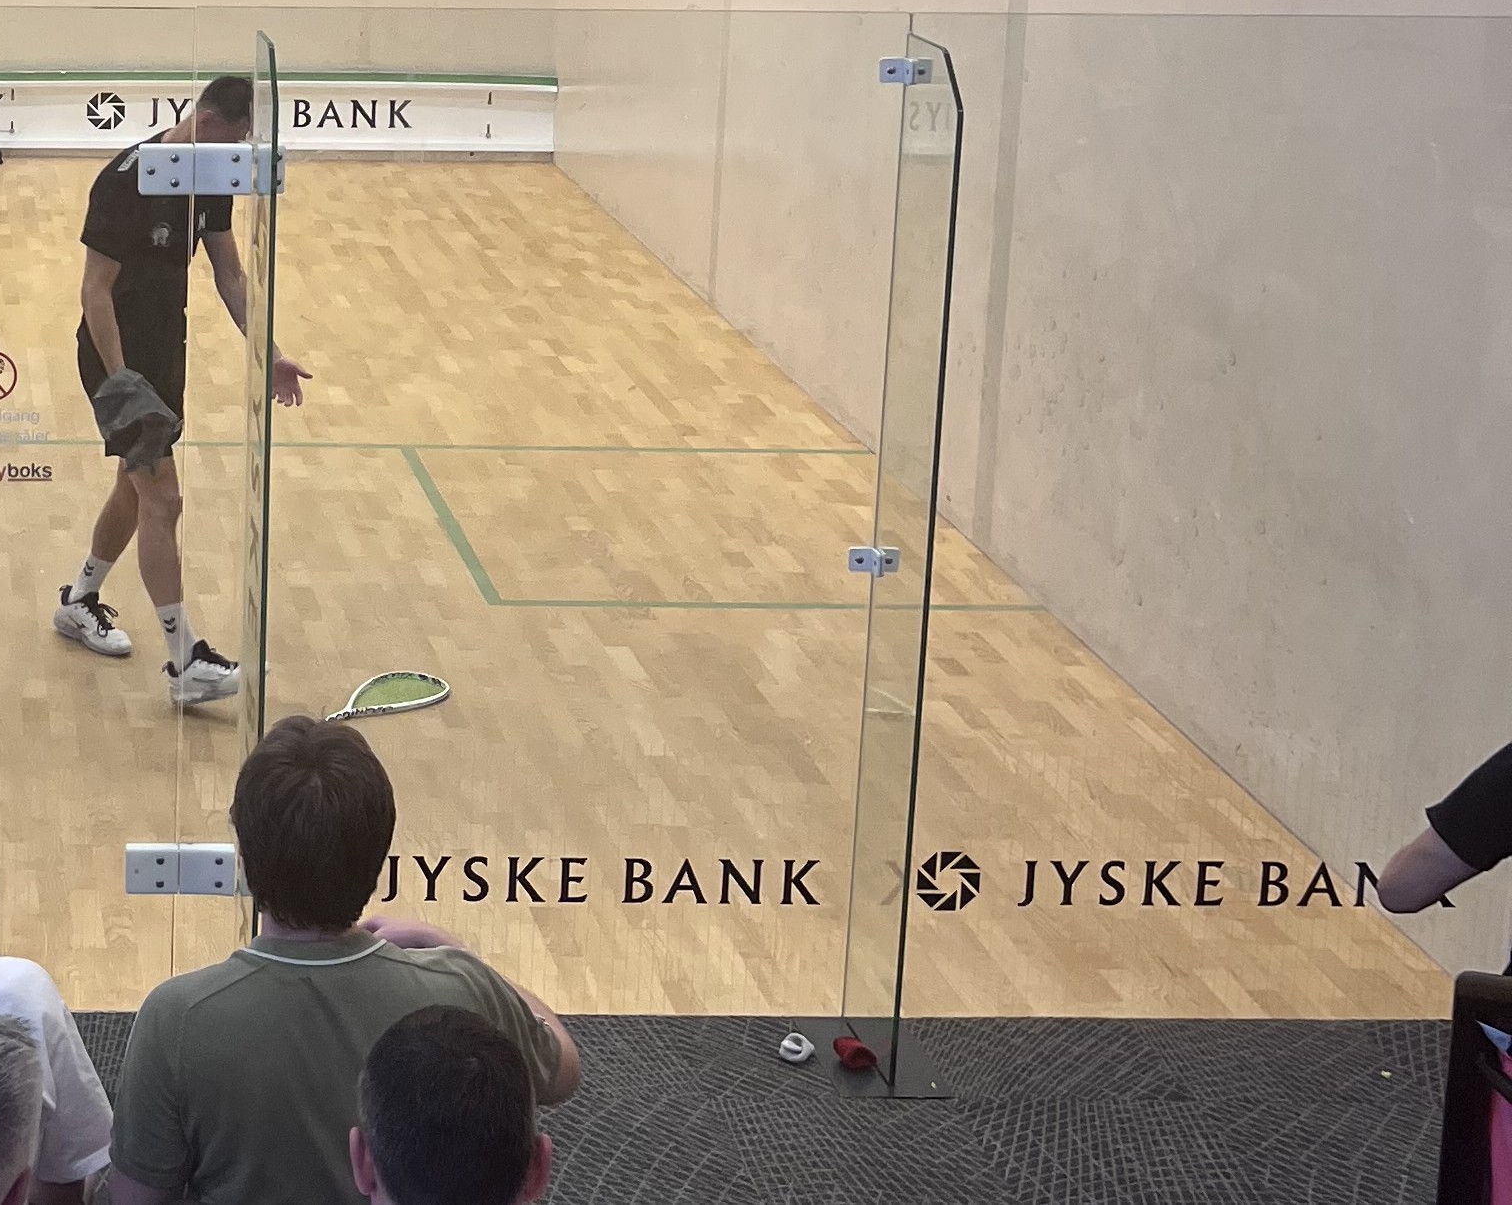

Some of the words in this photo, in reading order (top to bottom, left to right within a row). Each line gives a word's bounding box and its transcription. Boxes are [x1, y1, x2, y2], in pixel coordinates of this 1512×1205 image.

[292, 98, 413, 130] BANK
[382, 855, 589, 903] JYSKE
[621, 857, 821, 905] BANK
[1017, 859, 1225, 908] JYSKE
